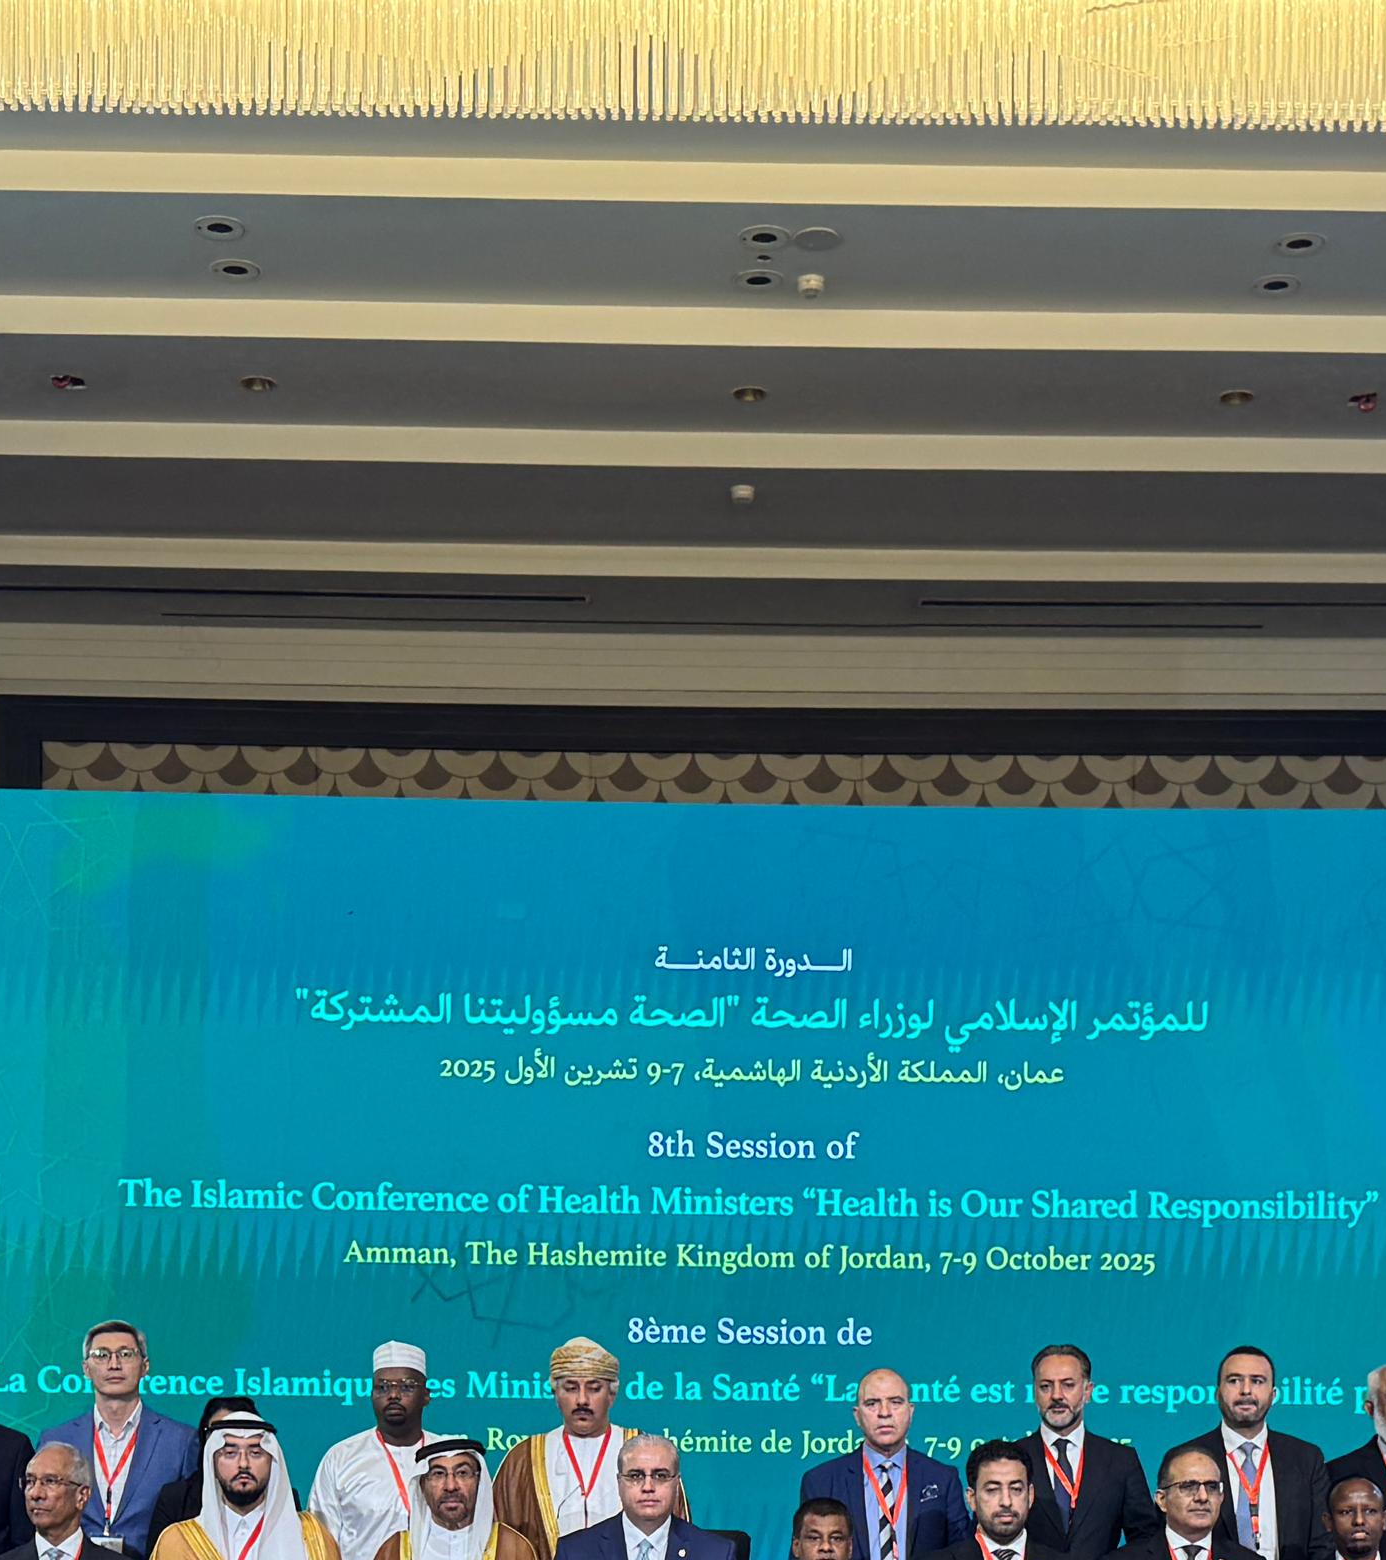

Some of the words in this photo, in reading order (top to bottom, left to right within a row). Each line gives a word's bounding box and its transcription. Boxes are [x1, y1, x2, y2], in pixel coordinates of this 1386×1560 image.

[463, 992, 618, 1035] مسؤوليتنا
[750, 996, 848, 1030] الصحة
[858, 997, 935, 1040] لوزراء
[944, 997, 1078, 1053] الإسلامي
[1085, 998, 1209, 1041] للمؤتمر
[439, 1058, 496, 1084] 2025
[504, 1047, 556, 1085] الأول
[564, 1057, 638, 1087] تشرين
[810, 1051, 888, 1089] الأردنية
[897, 1059, 988, 1084] المملكة
[648, 1129, 696, 1158] 8th
[706, 1130, 817, 1159] Session
[826, 1131, 860, 1160] of
[117, 1177, 182, 1208] The
[190, 1178, 304, 1210] Islamic
[311, 1181, 489, 1213] Conference
[497, 1183, 532, 1213] of
[538, 1185, 642, 1215] Health
[650, 1186, 794, 1217] Ministers
[928, 1189, 953, 1218] is
[960, 1189, 1024, 1219] Our
[1031, 1188, 1139, 1219] Shared
[342, 1239, 457, 1269] Amman,
[464, 1240, 518, 1266] The
[527, 1241, 667, 1267] Hashemite
[676, 1242, 796, 1275] Kingdom
[804, 1243, 834, 1269] of
[838, 1244, 931, 1275] Jordan,
[939, 1251, 977, 1275] 7-9
[985, 1245, 1092, 1271] October
[1100, 1252, 1156, 1277] 2025
[627, 1316, 707, 1344] 8ème
[716, 1317, 827, 1345] Session
[836, 1317, 873, 1346] de
[234, 1366, 373, 1405] Islamiqu
[426, 1377, 456, 1399] es
[466, 1371, 555, 1400] Minis
[625, 1372, 663, 1400] de
[673, 1371, 702, 1401] la
[711, 1373, 801, 1402] Santé
[909, 1374, 961, 1403] nté
[969, 1379, 1016, 1404] est
[760, 1427, 792, 1454] de
[923, 1436, 962, 1460] 7-9
